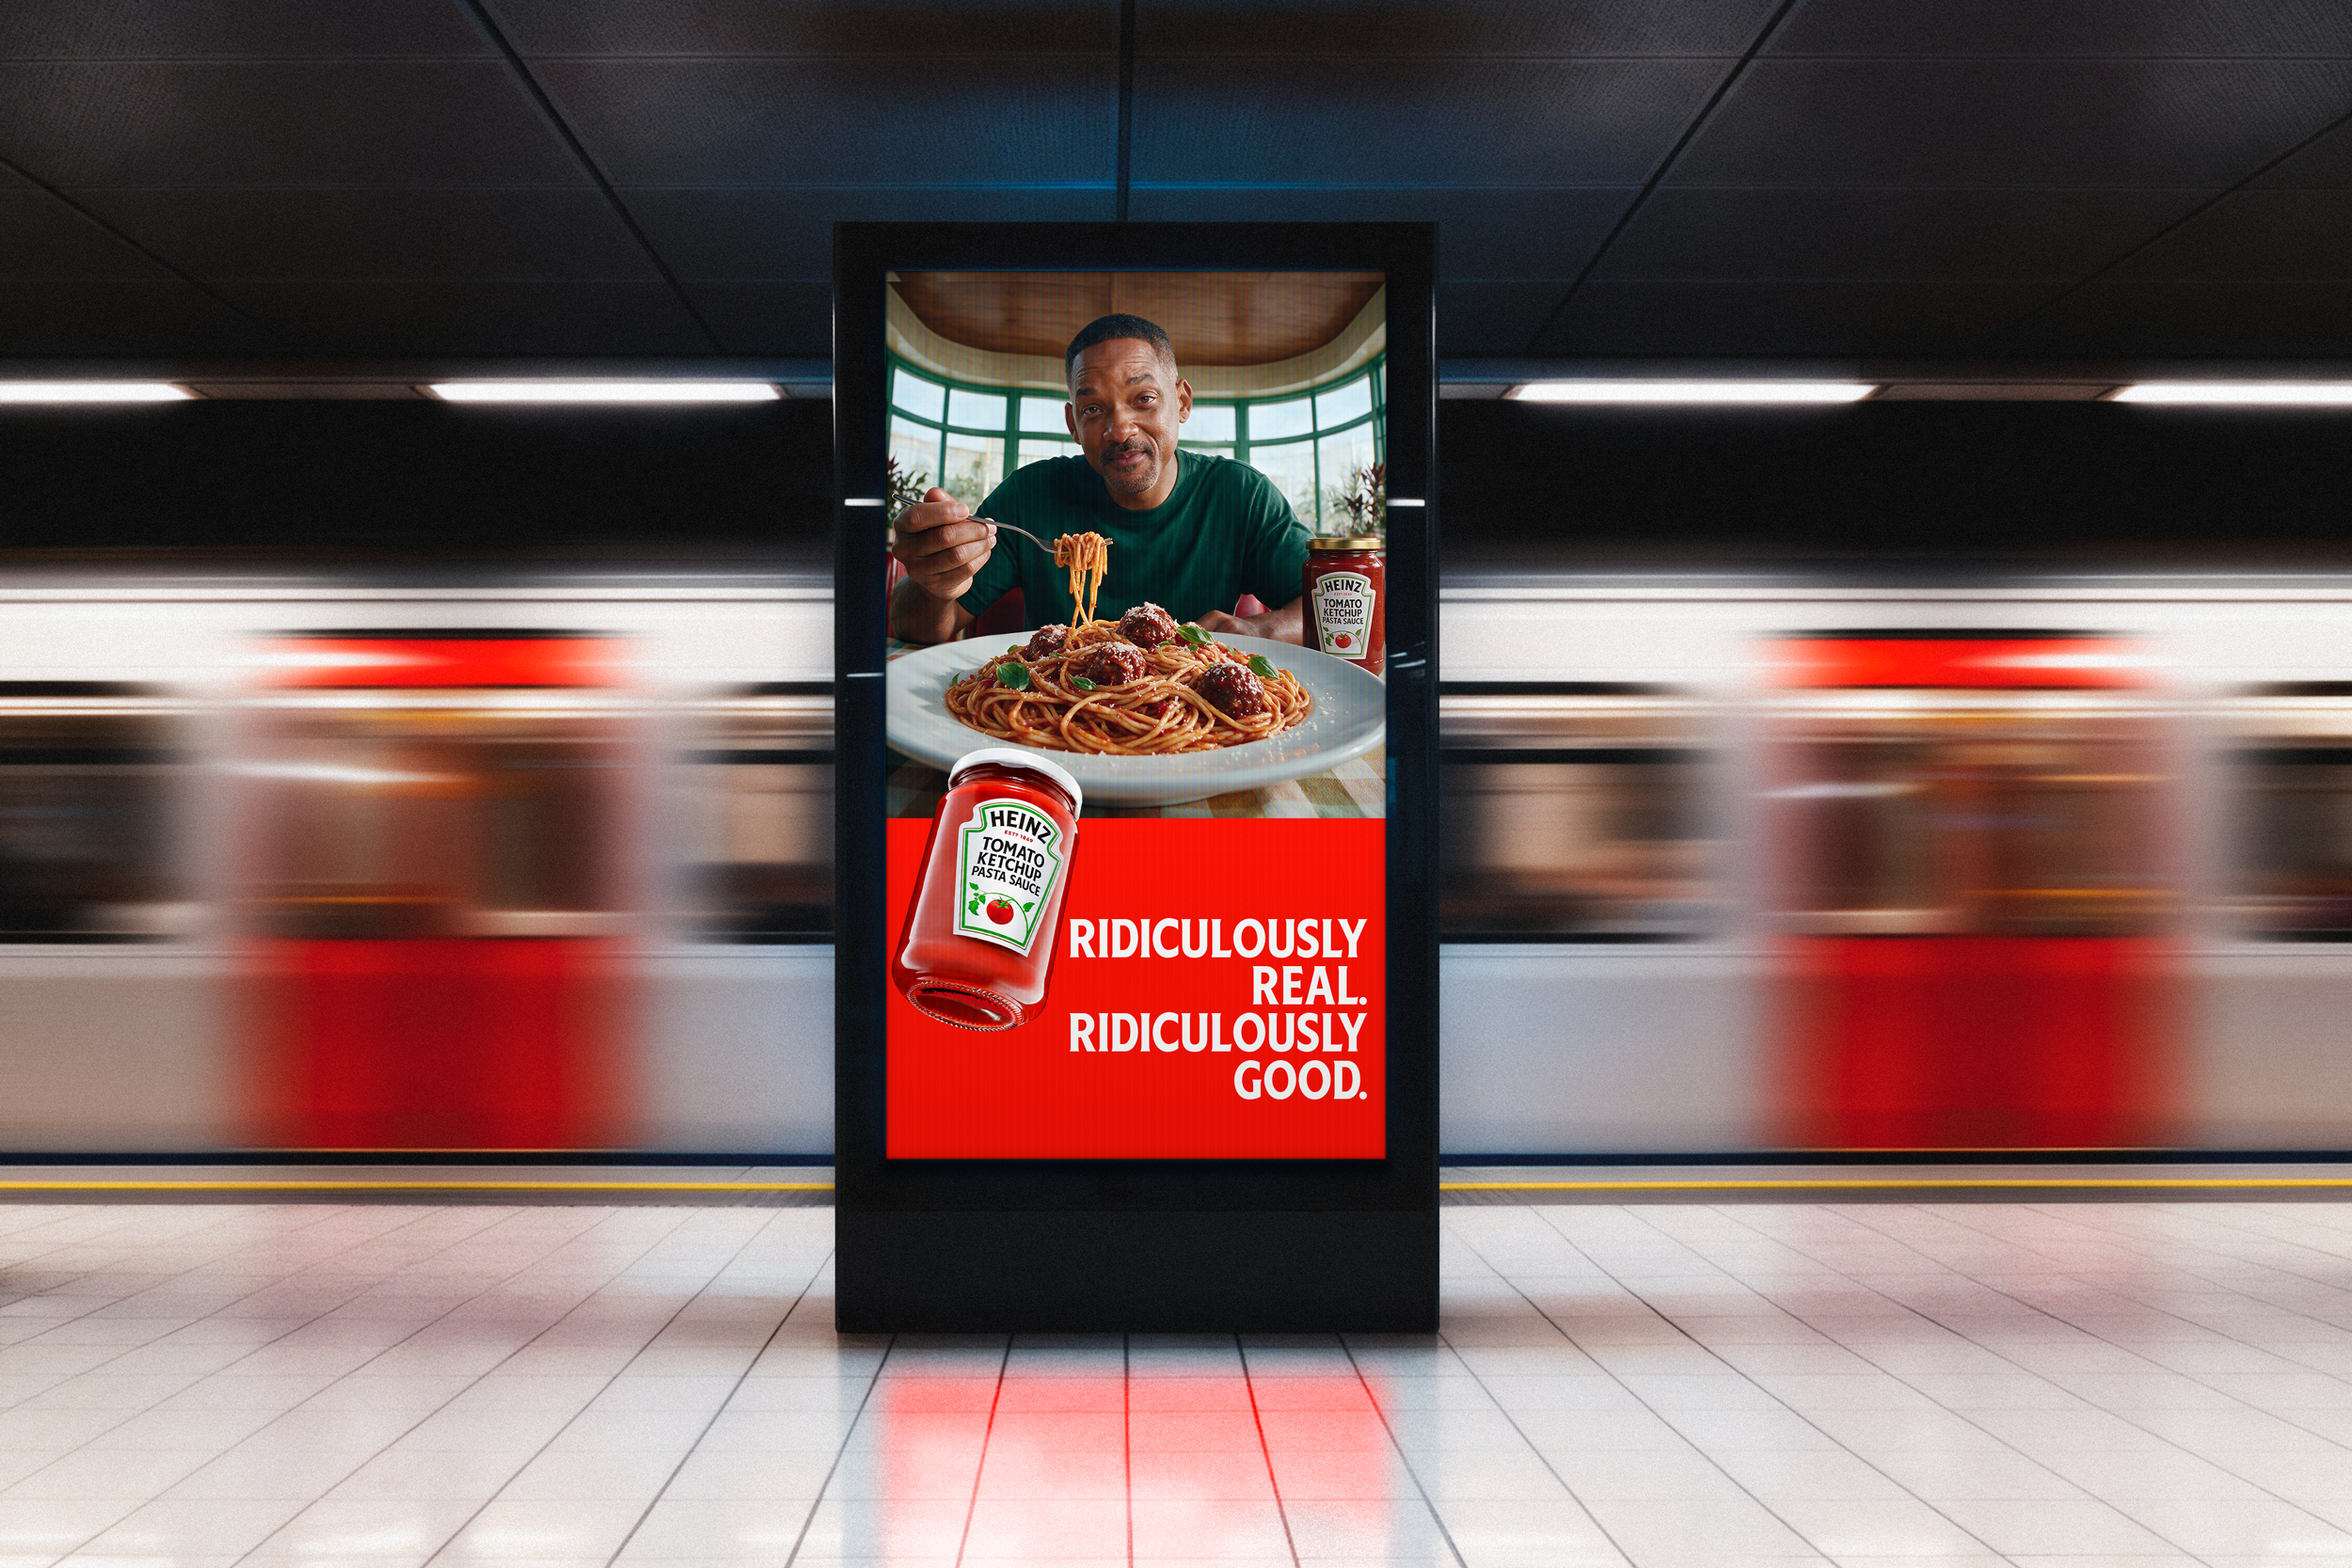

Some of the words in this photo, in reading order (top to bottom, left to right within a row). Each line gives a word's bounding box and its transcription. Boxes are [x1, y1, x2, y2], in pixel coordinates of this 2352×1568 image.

[1324, 579, 1362, 593] HEINZ
[1324, 598, 1362, 609] TOMATO
[1324, 608, 1362, 618] KETCHUP
[1322, 616, 1342, 625] PASTA
[990, 810, 1052, 845] HEINZ
[1020, 834, 1034, 843] 1869
[977, 851, 1041, 882] KETCHUP
[982, 836, 1045, 868] TOMATO
[971, 865, 1007, 883] PASTA
[1009, 874, 1041, 897] SAUCE
[1069, 917, 1368, 958] RIDICULOUSLY
[1252, 965, 1368, 1006] REAL.
[1069, 1011, 1368, 1053] RIDICULOUSLY
[1233, 1059, 1368, 1101] GOOD.
